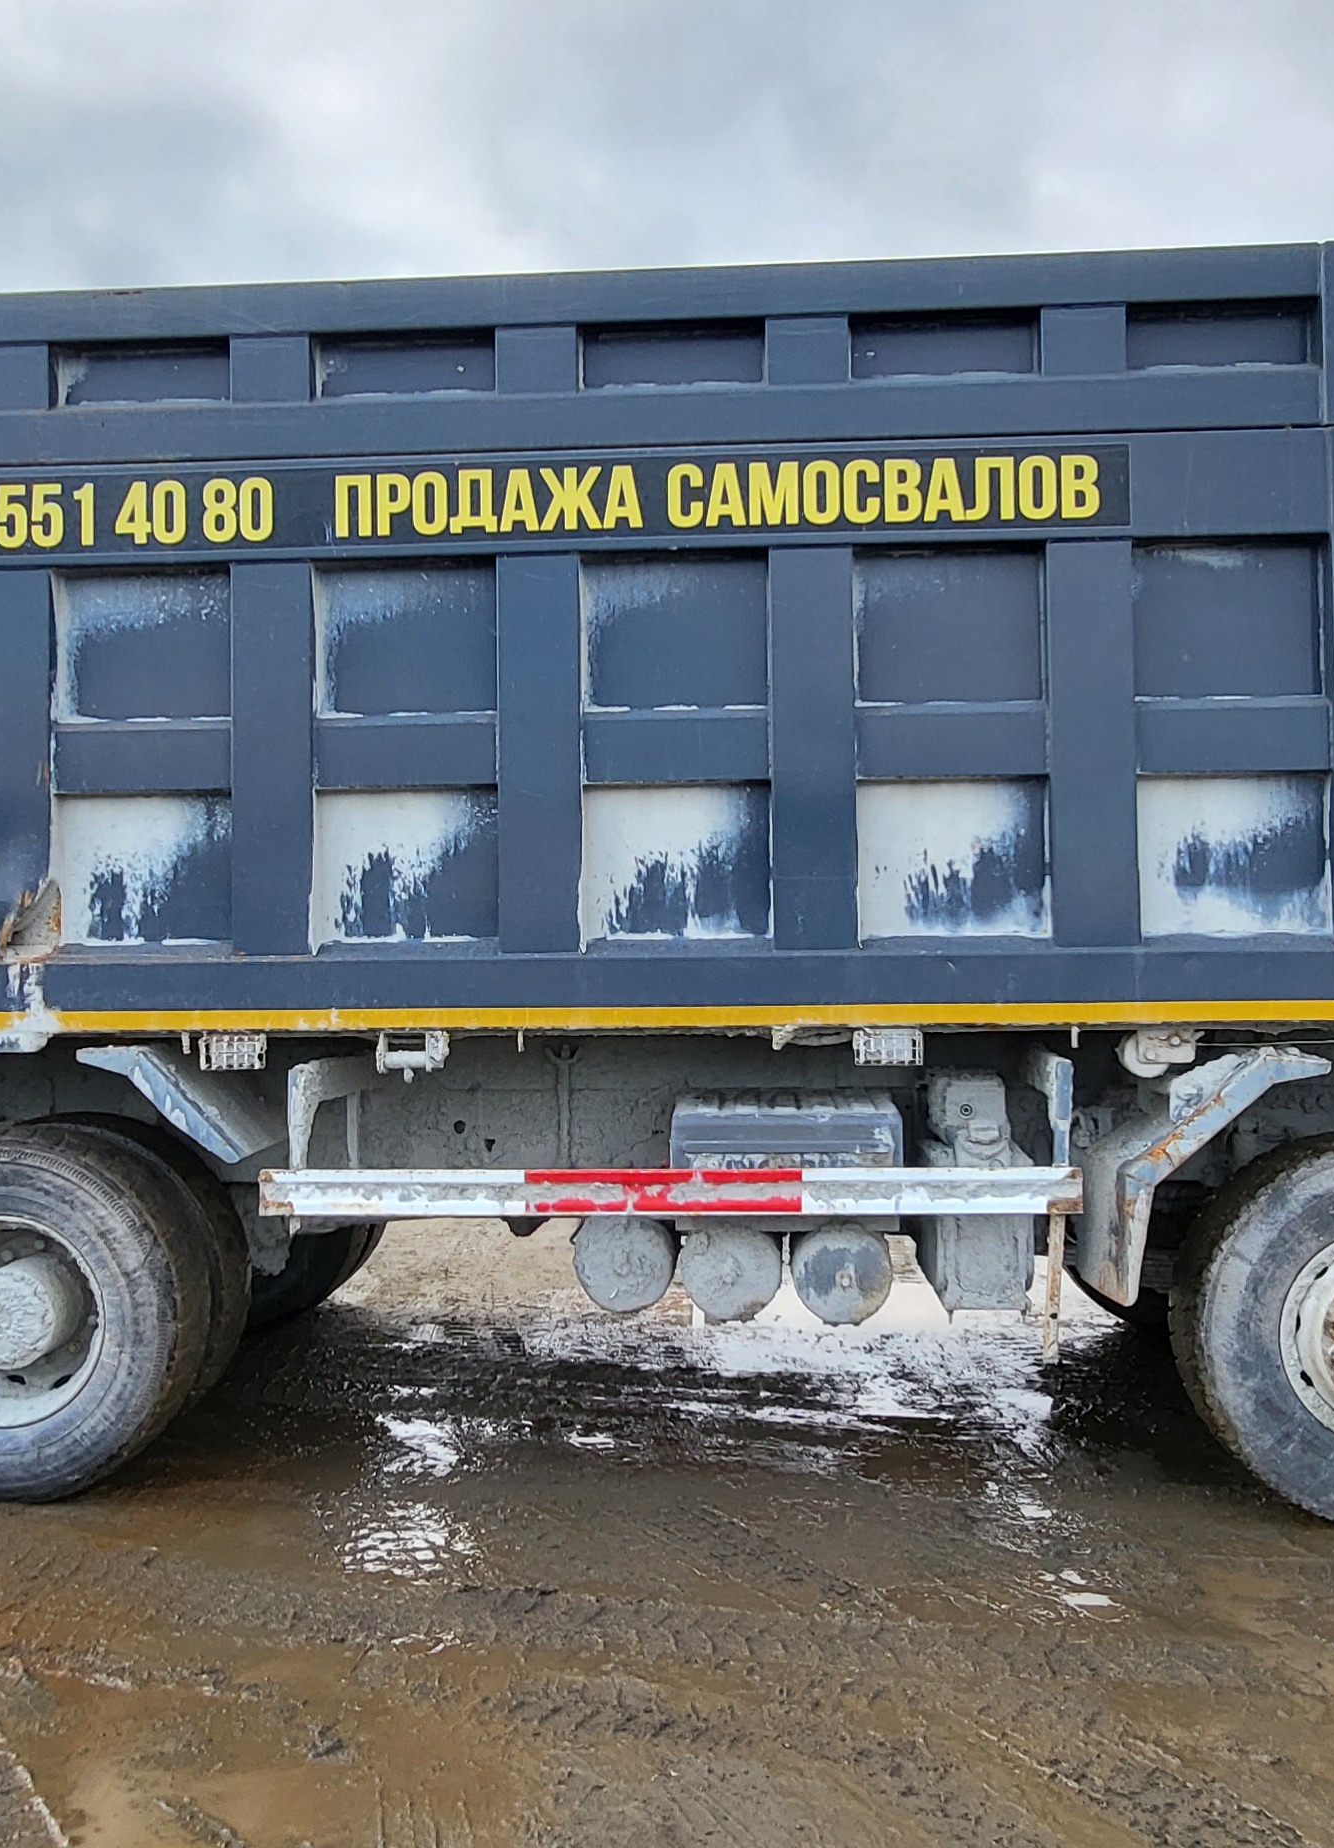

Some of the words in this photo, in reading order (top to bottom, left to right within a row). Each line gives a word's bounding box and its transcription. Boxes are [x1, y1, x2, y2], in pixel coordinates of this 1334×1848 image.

[114, 479, 187, 545] 40
[202, 476, 274, 543] 80
[334, 465, 644, 538] ПРОДАЖА
[667, 453, 1101, 527] САМОСВАЛОВ
